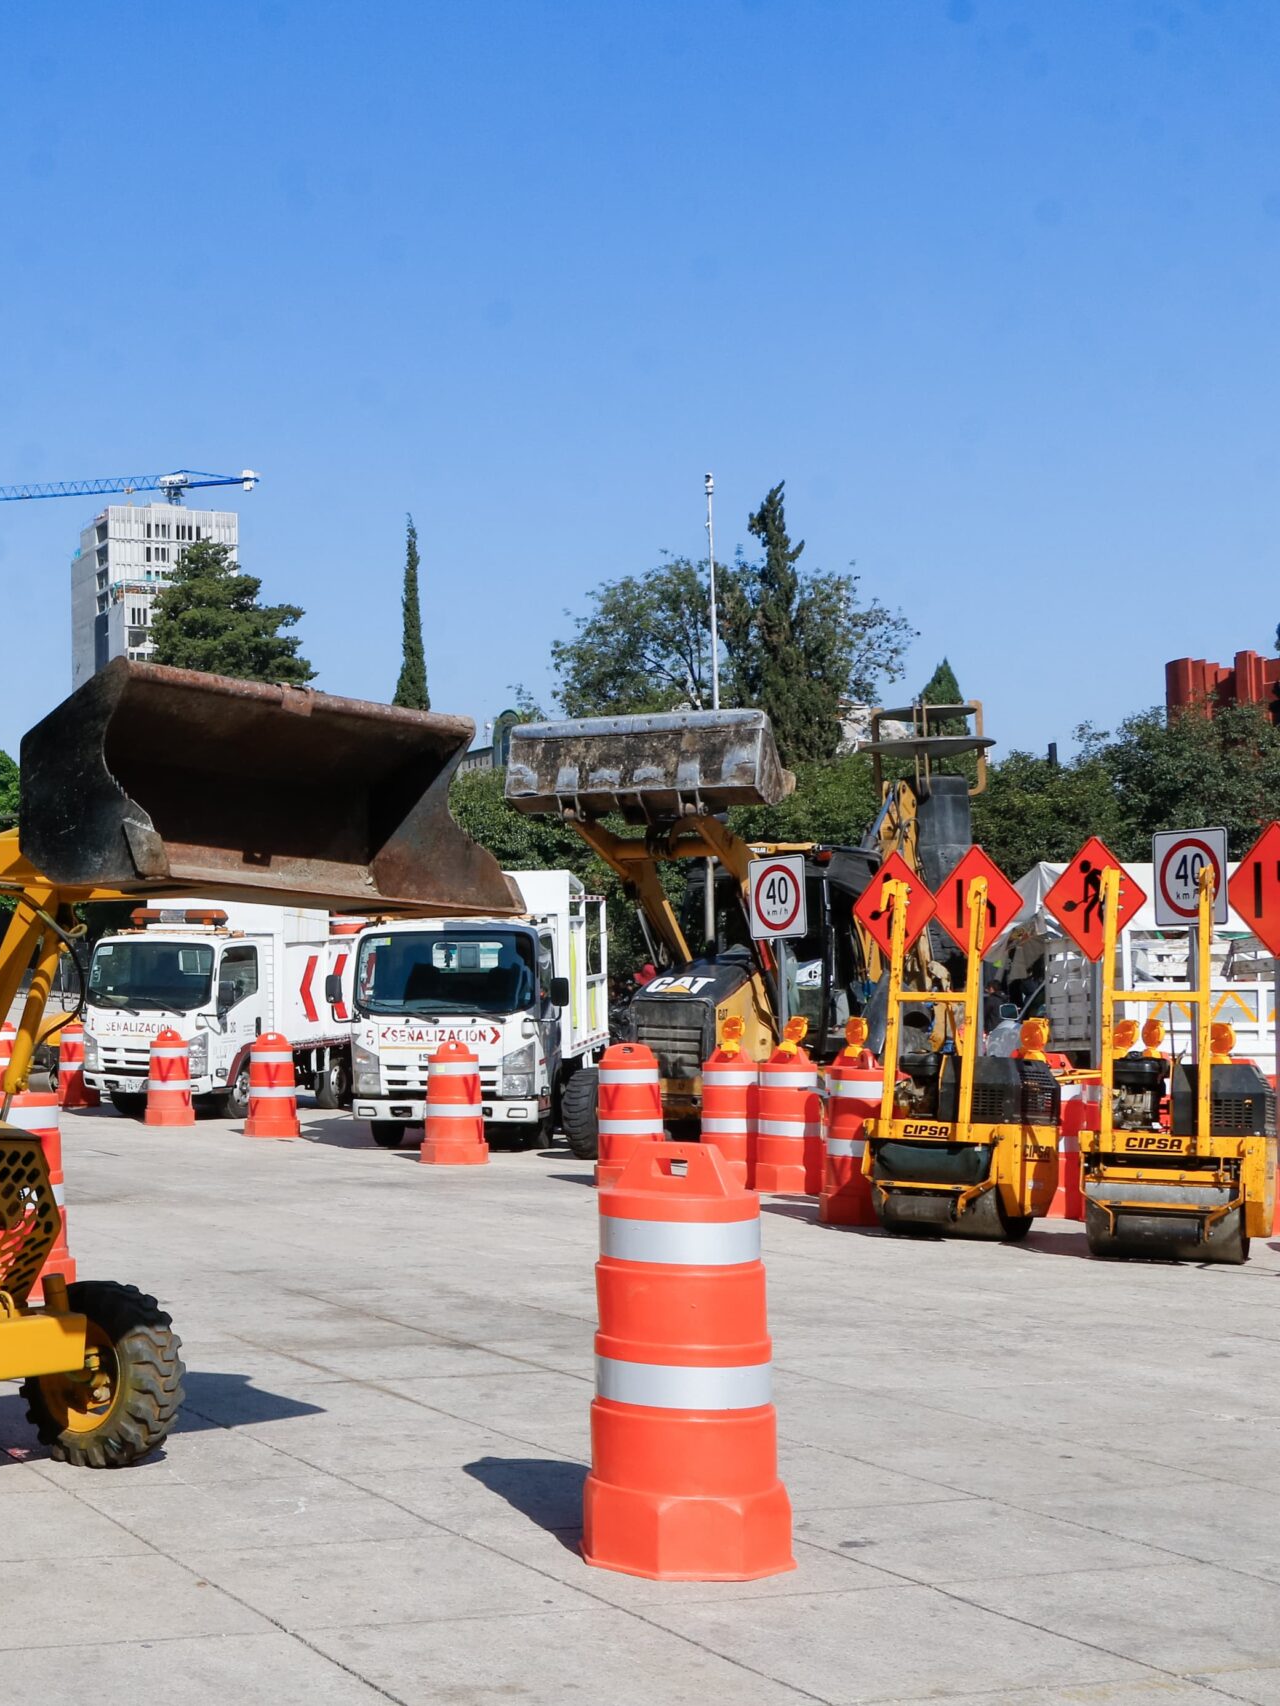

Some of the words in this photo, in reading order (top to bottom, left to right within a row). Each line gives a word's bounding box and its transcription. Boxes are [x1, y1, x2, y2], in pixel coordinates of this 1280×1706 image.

[1173, 852, 1205, 887] 40
[766, 876, 788, 905] 40
[646, 976, 716, 994] CAT
[366, 1030, 374, 1046] 5
[903, 1124, 949, 1137] CIPSA
[1024, 1144, 1050, 1159] CIPSA
[1125, 1137, 1183, 1150] CIPSA
